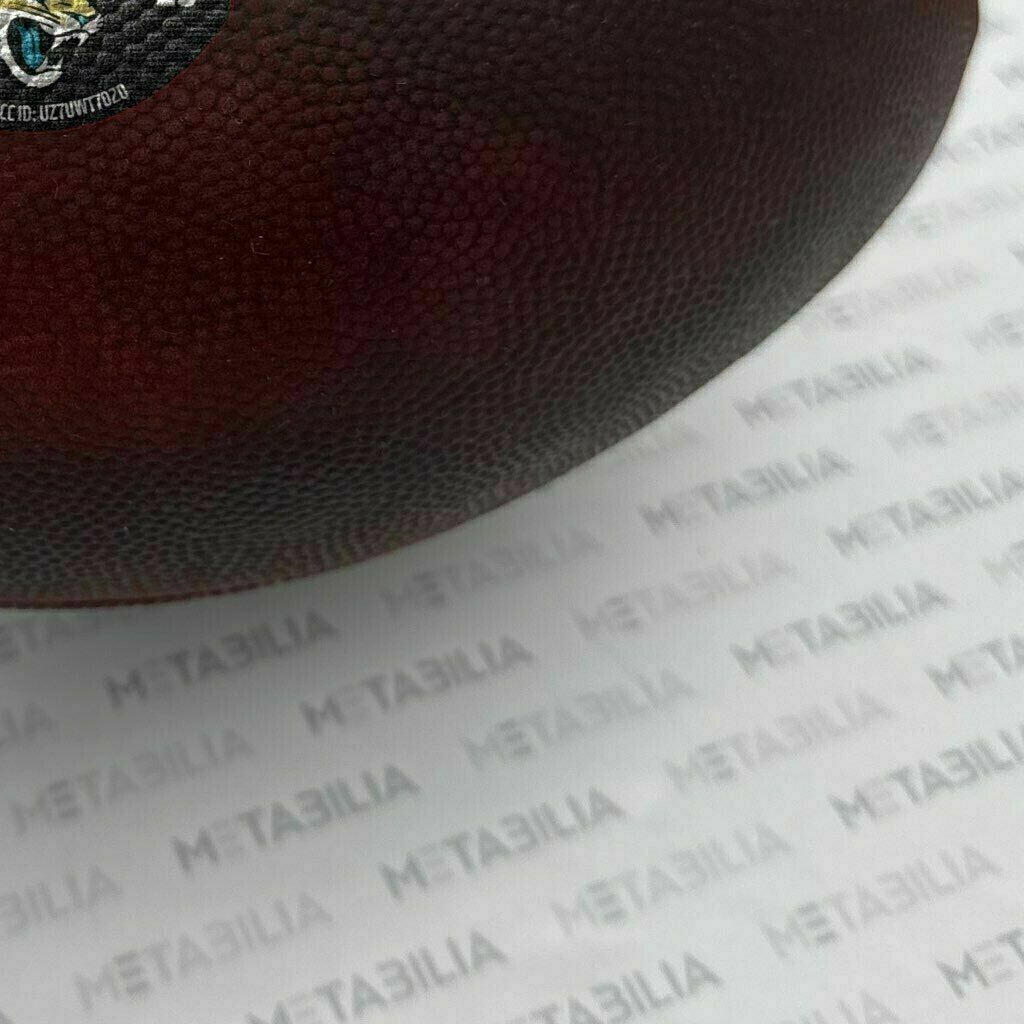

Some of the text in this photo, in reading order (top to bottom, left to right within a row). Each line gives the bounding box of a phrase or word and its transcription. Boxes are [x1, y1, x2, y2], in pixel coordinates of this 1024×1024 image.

[17, 104, 37, 123] ID:
[171, 762, 422, 875] METABILIA
[827, 726, 1024, 831] METABILI
[378, 785, 627, 904] METABILIA
[72, 890, 336, 1013] METABILIA
